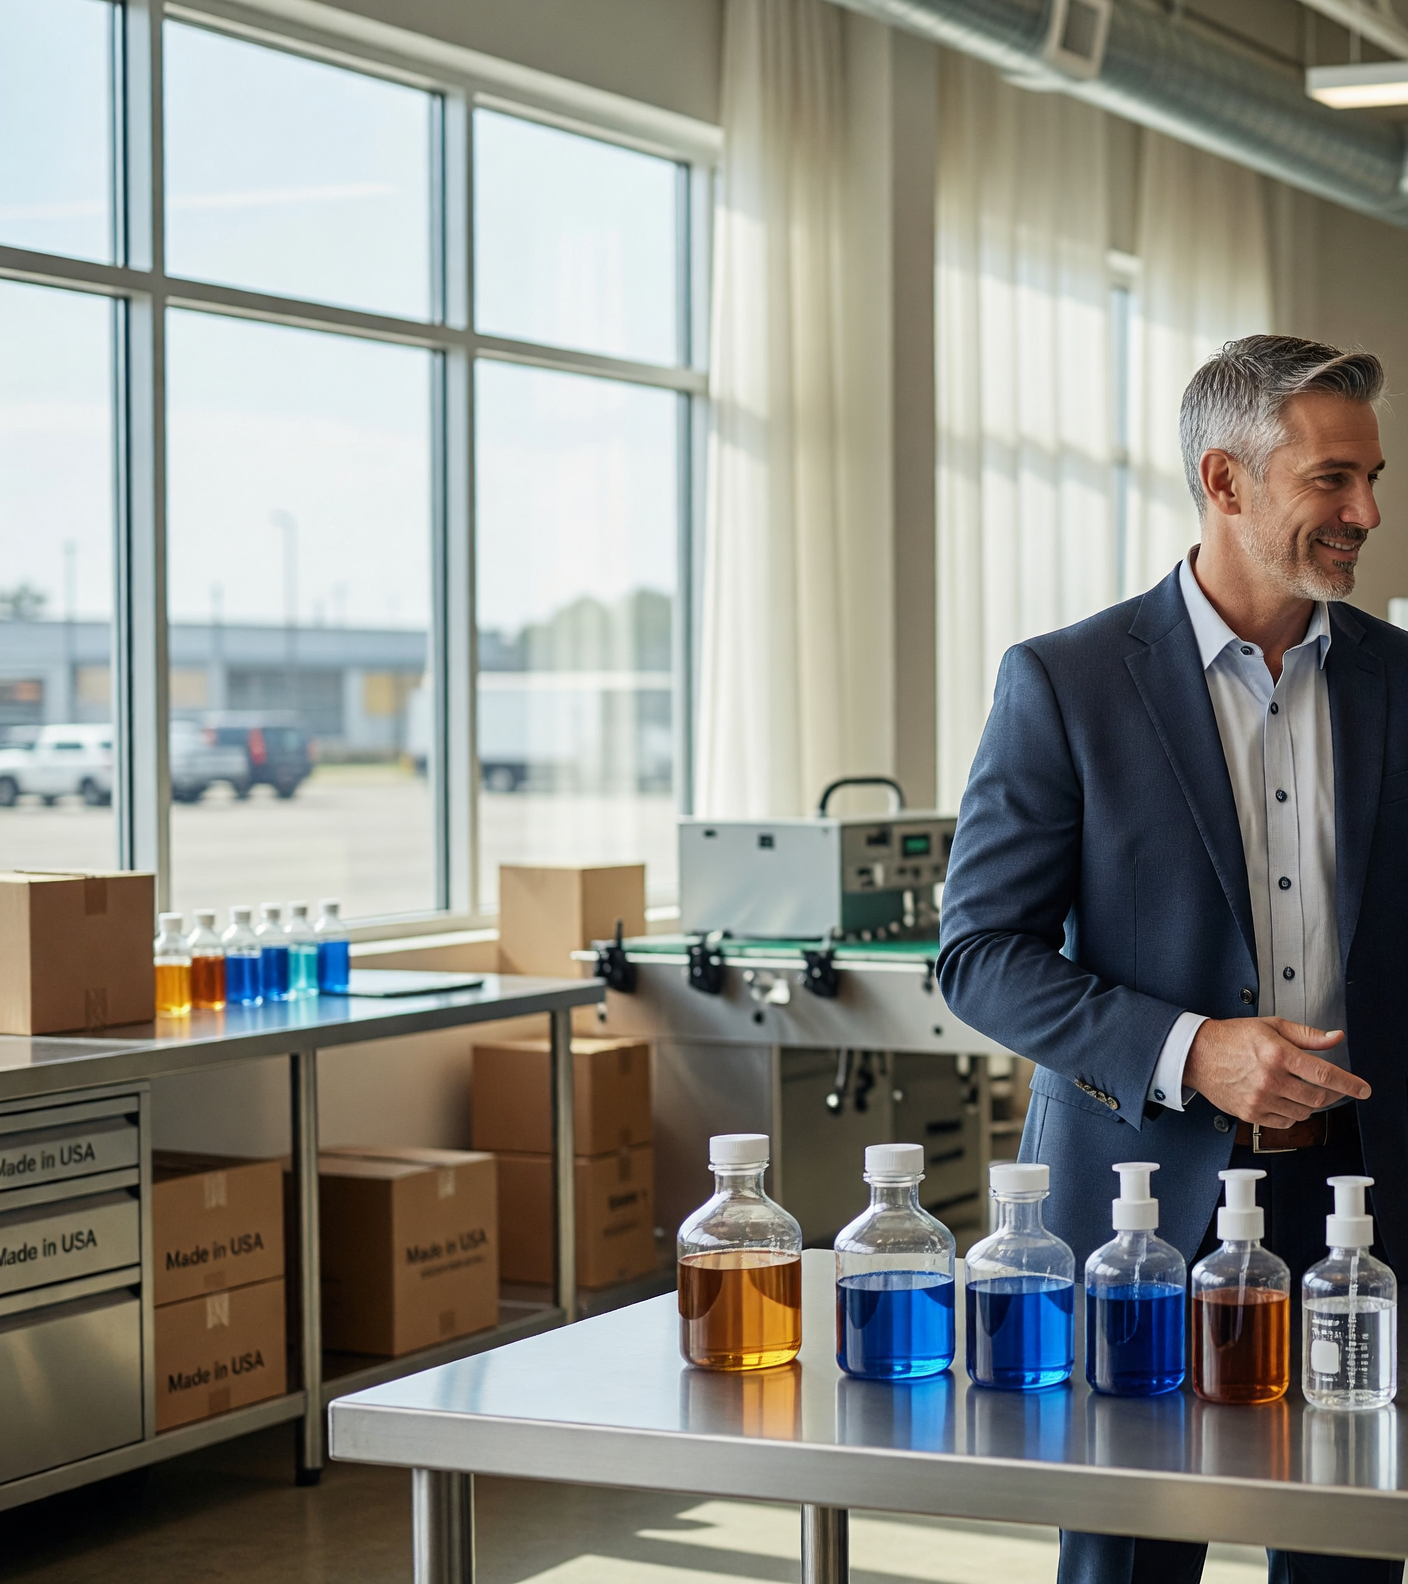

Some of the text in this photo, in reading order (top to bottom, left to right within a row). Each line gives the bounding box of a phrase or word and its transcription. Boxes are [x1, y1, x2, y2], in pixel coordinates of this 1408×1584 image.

[41, 1151, 55, 1170] in
[60, 1142, 96, 1166] USA
[43, 1238, 56, 1257] in
[62, 1229, 98, 1253] USA
[166, 1232, 265, 1271] Made in USA
[406, 1227, 489, 1266] Made in USA
[168, 1350, 265, 1394] Made in USA
